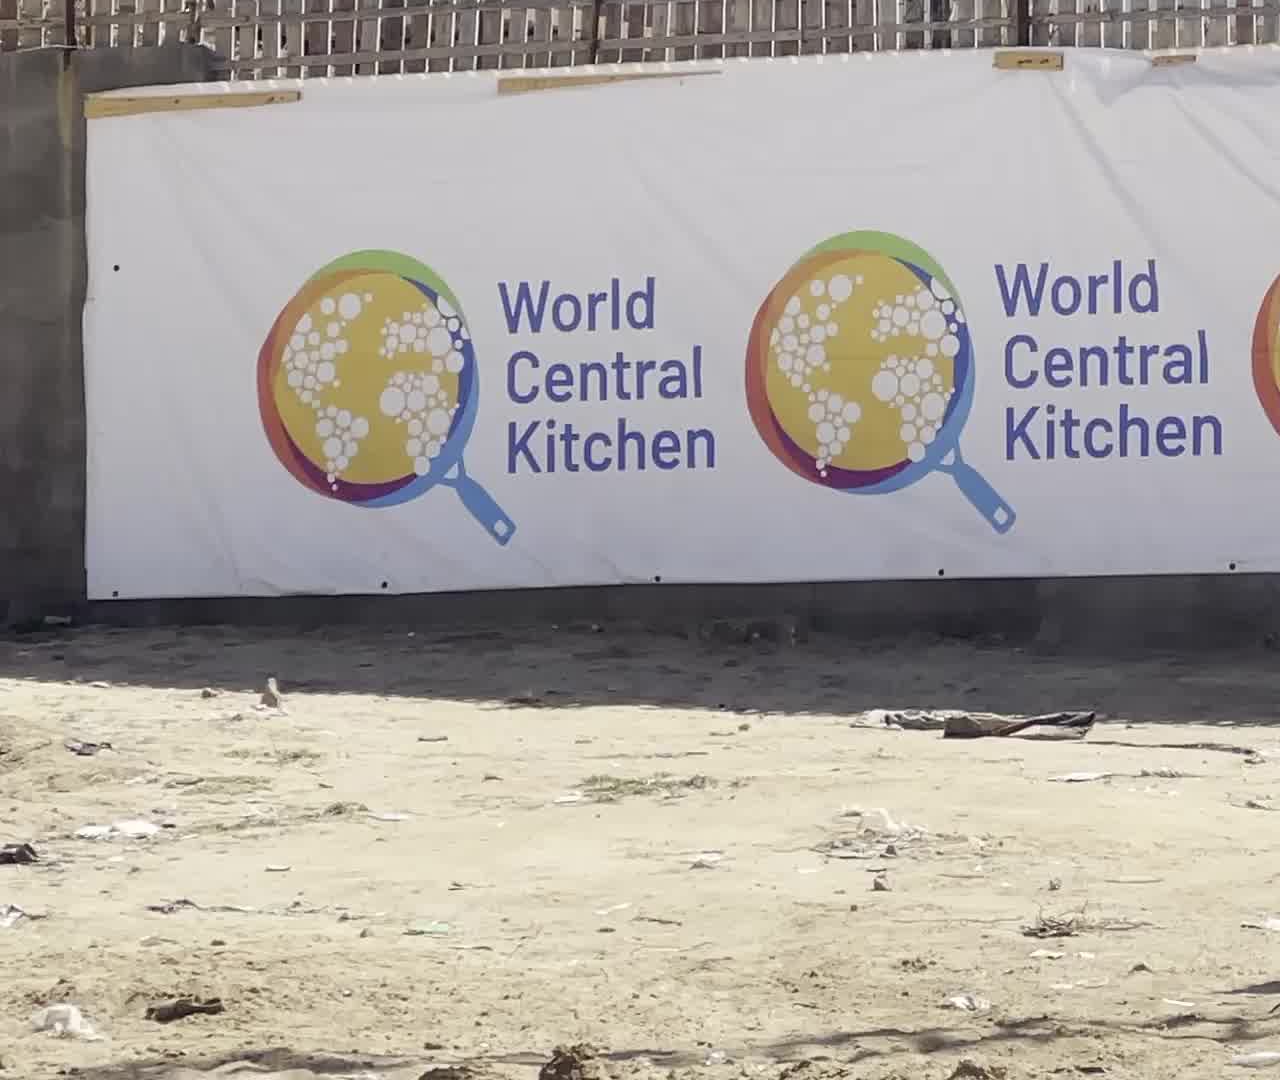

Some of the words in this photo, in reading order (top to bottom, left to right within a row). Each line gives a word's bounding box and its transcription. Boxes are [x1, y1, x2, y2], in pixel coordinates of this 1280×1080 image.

[499, 277, 656, 332] World
[993, 260, 1158, 316] World
[506, 344, 703, 405] Central
[1005, 331, 1210, 390] Central
[506, 419, 717, 474] Kitchen
[1005, 402, 1224, 459] Kitchen
